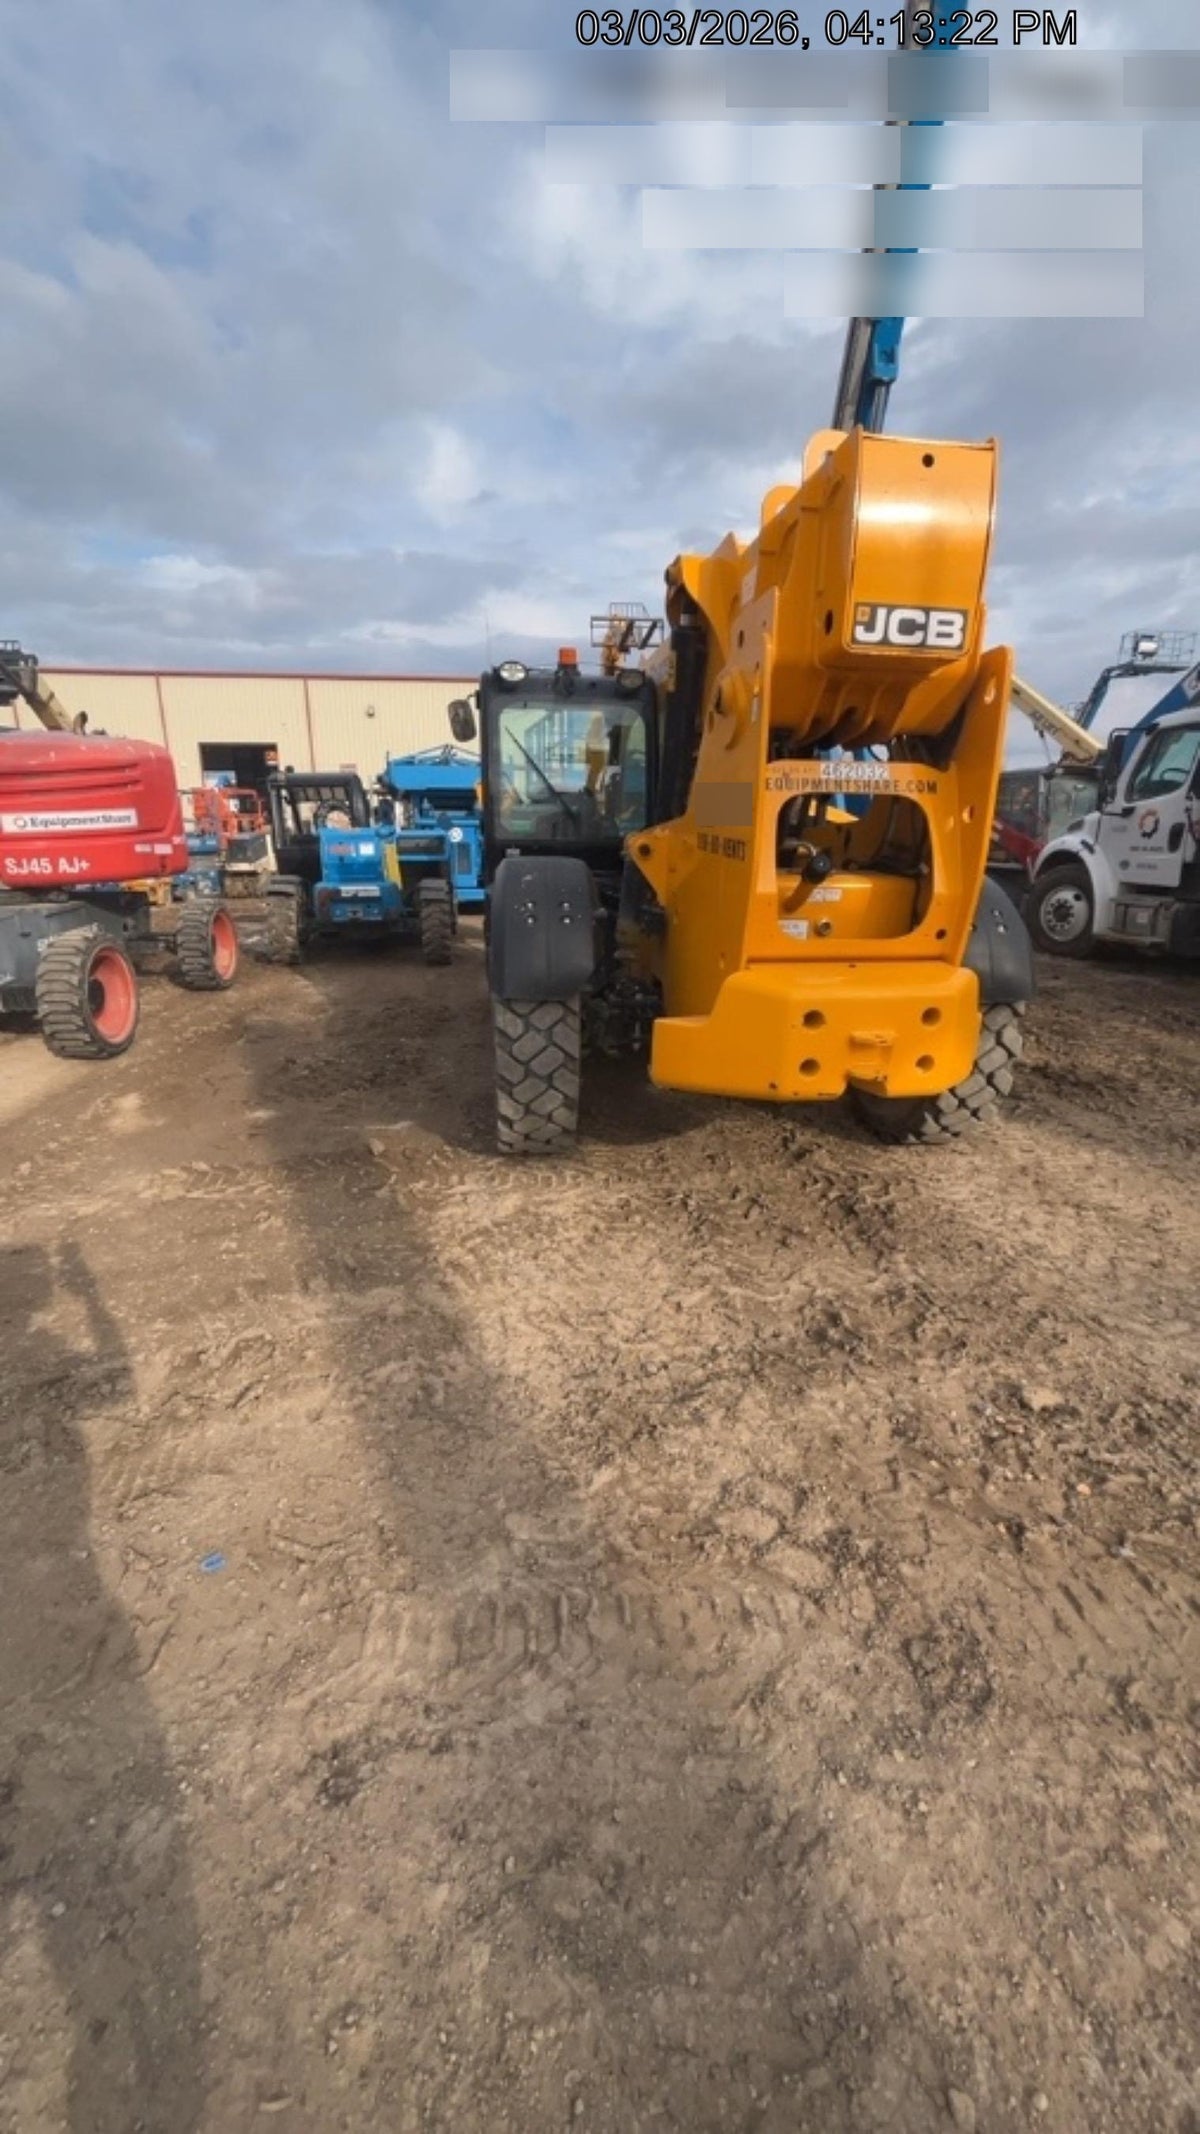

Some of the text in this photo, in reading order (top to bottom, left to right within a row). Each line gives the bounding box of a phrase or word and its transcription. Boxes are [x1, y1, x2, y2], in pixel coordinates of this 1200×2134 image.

[854, 606, 964, 648] JCB
[821, 762, 888, 779] 462032
[765, 777, 938, 794] EQUIPMENTSHARE.COM
[4, 856, 90, 875] SJ45 AJ+
